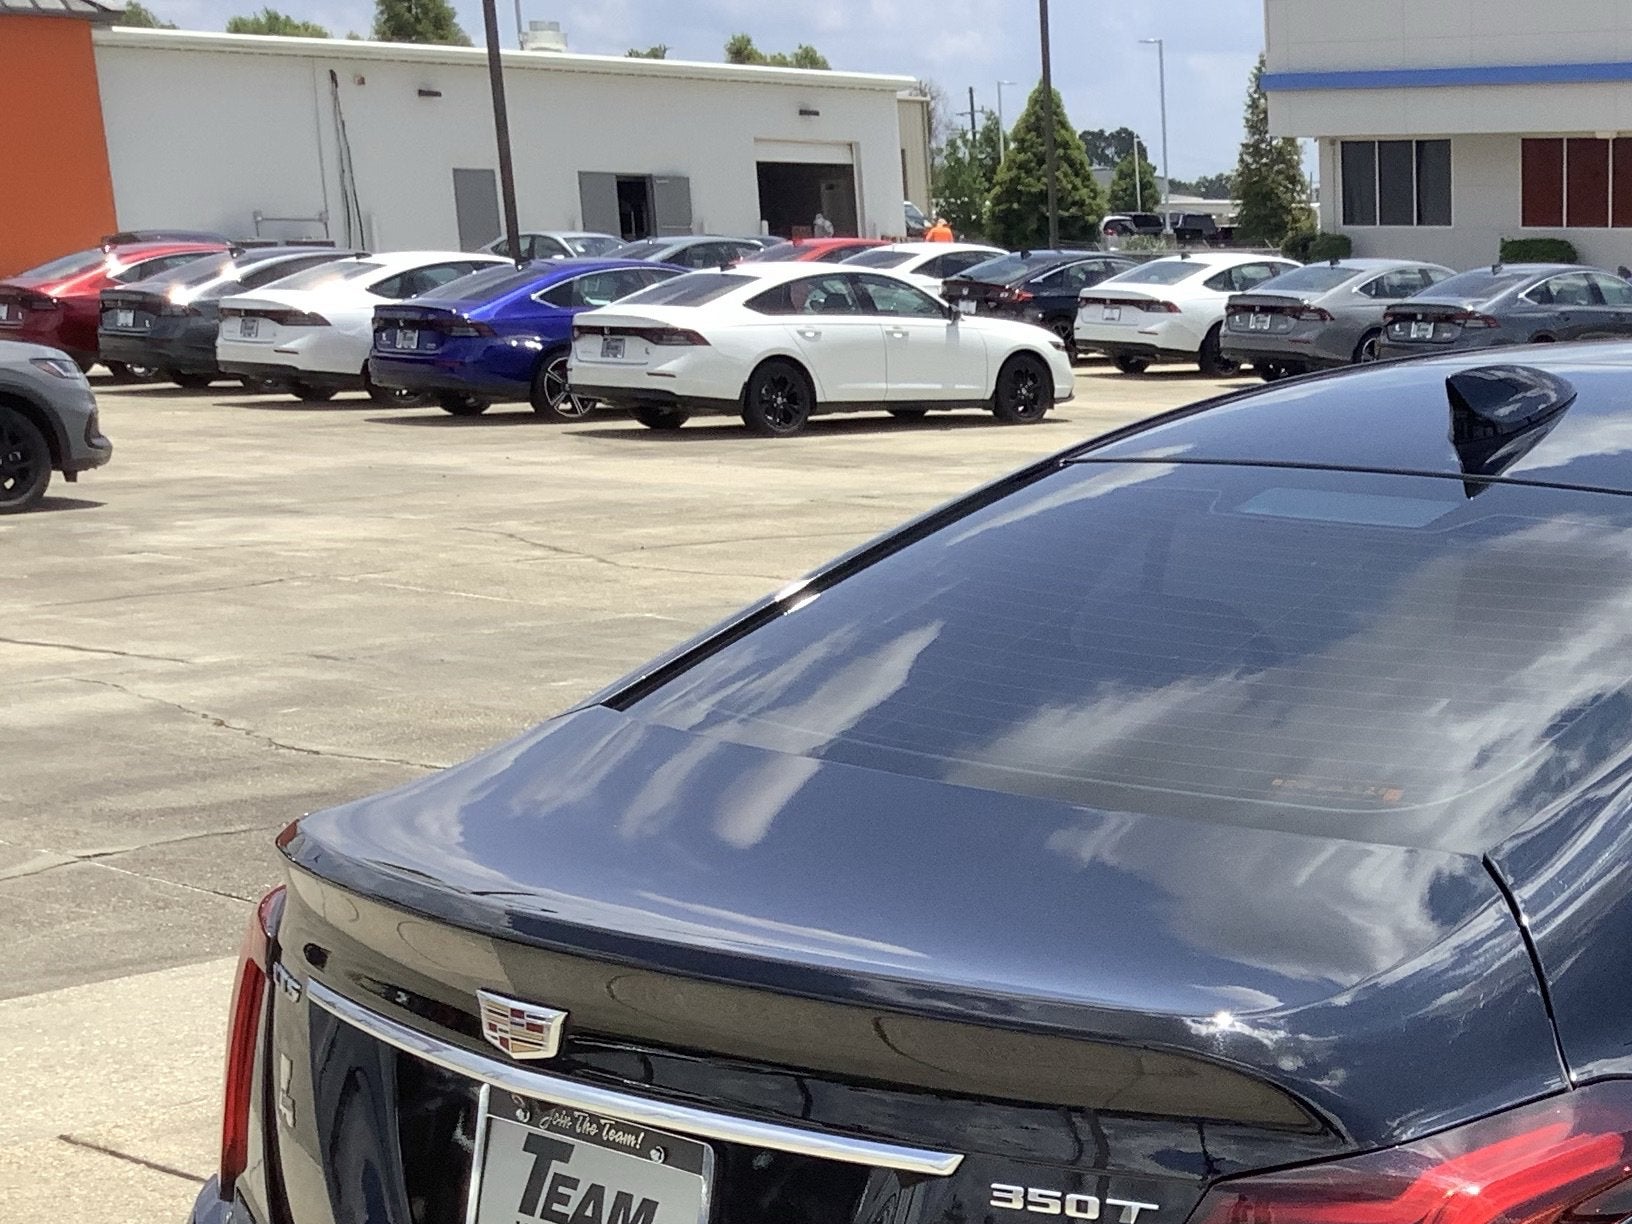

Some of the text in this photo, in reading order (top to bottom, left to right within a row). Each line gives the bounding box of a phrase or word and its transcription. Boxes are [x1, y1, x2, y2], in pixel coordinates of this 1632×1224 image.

[539, 1109, 645, 1149] Join The Team!
[989, 1183, 1159, 1224] 350T
